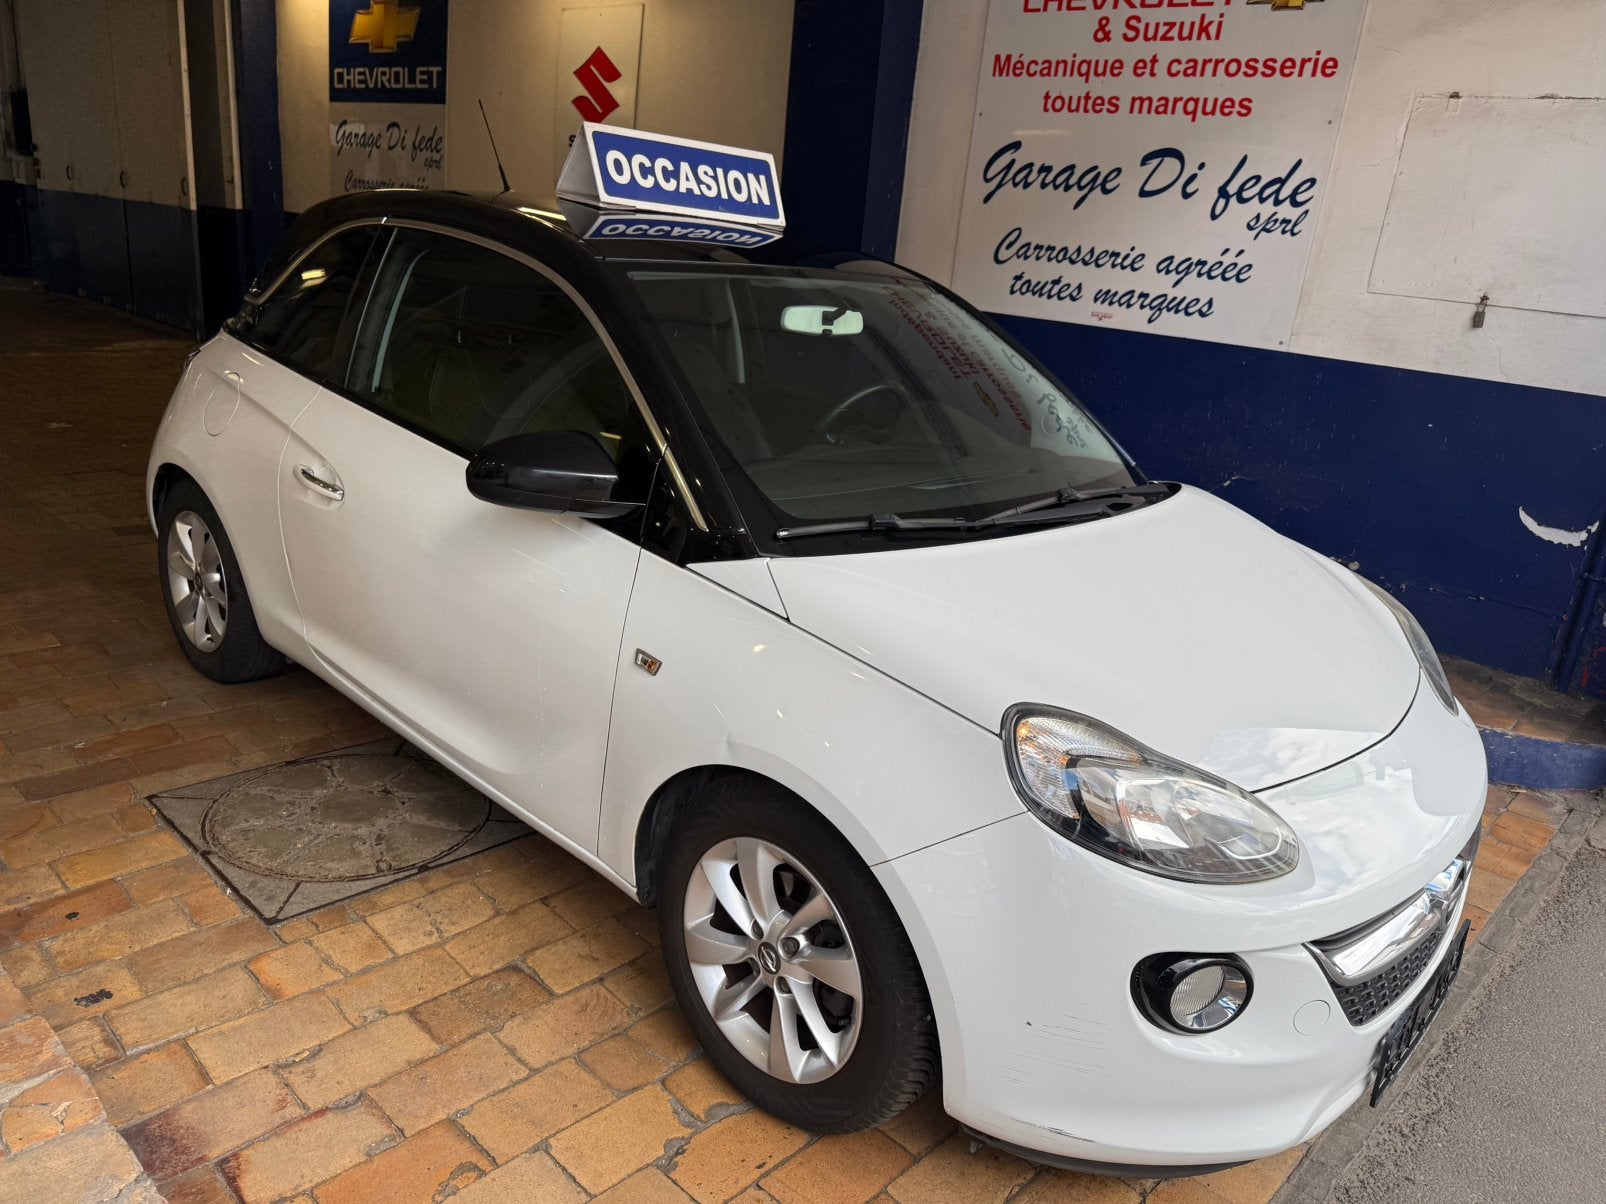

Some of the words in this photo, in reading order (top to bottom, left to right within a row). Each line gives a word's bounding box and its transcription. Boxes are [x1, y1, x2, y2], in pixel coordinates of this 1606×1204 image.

[1093, 16, 1112, 43] &
[1122, 13, 1225, 42] Suzuki
[334, 66, 442, 89] CHEVROLET
[992, 53, 1124, 83] Mécanique
[1132, 53, 1159, 78] et
[1166, 50, 1339, 78] carrosserie
[1043, 90, 1120, 114] toutes
[1128, 96, 1253, 122] marques
[335, 119, 382, 158] Garage
[386, 121, 407, 151] Di
[412, 125, 443, 162] fede
[605, 149, 771, 206] OCCASION
[983, 140, 1122, 209] Garage
[1138, 147, 1205, 200] Di
[1210, 154, 1317, 220] fede
[1246, 209, 1309, 240] sprl
[993, 227, 1145, 272] Carrosserie
[1156, 248, 1253, 287] agréée
[1009, 271, 1083, 302] toutes
[1094, 285, 1214, 324] marques
